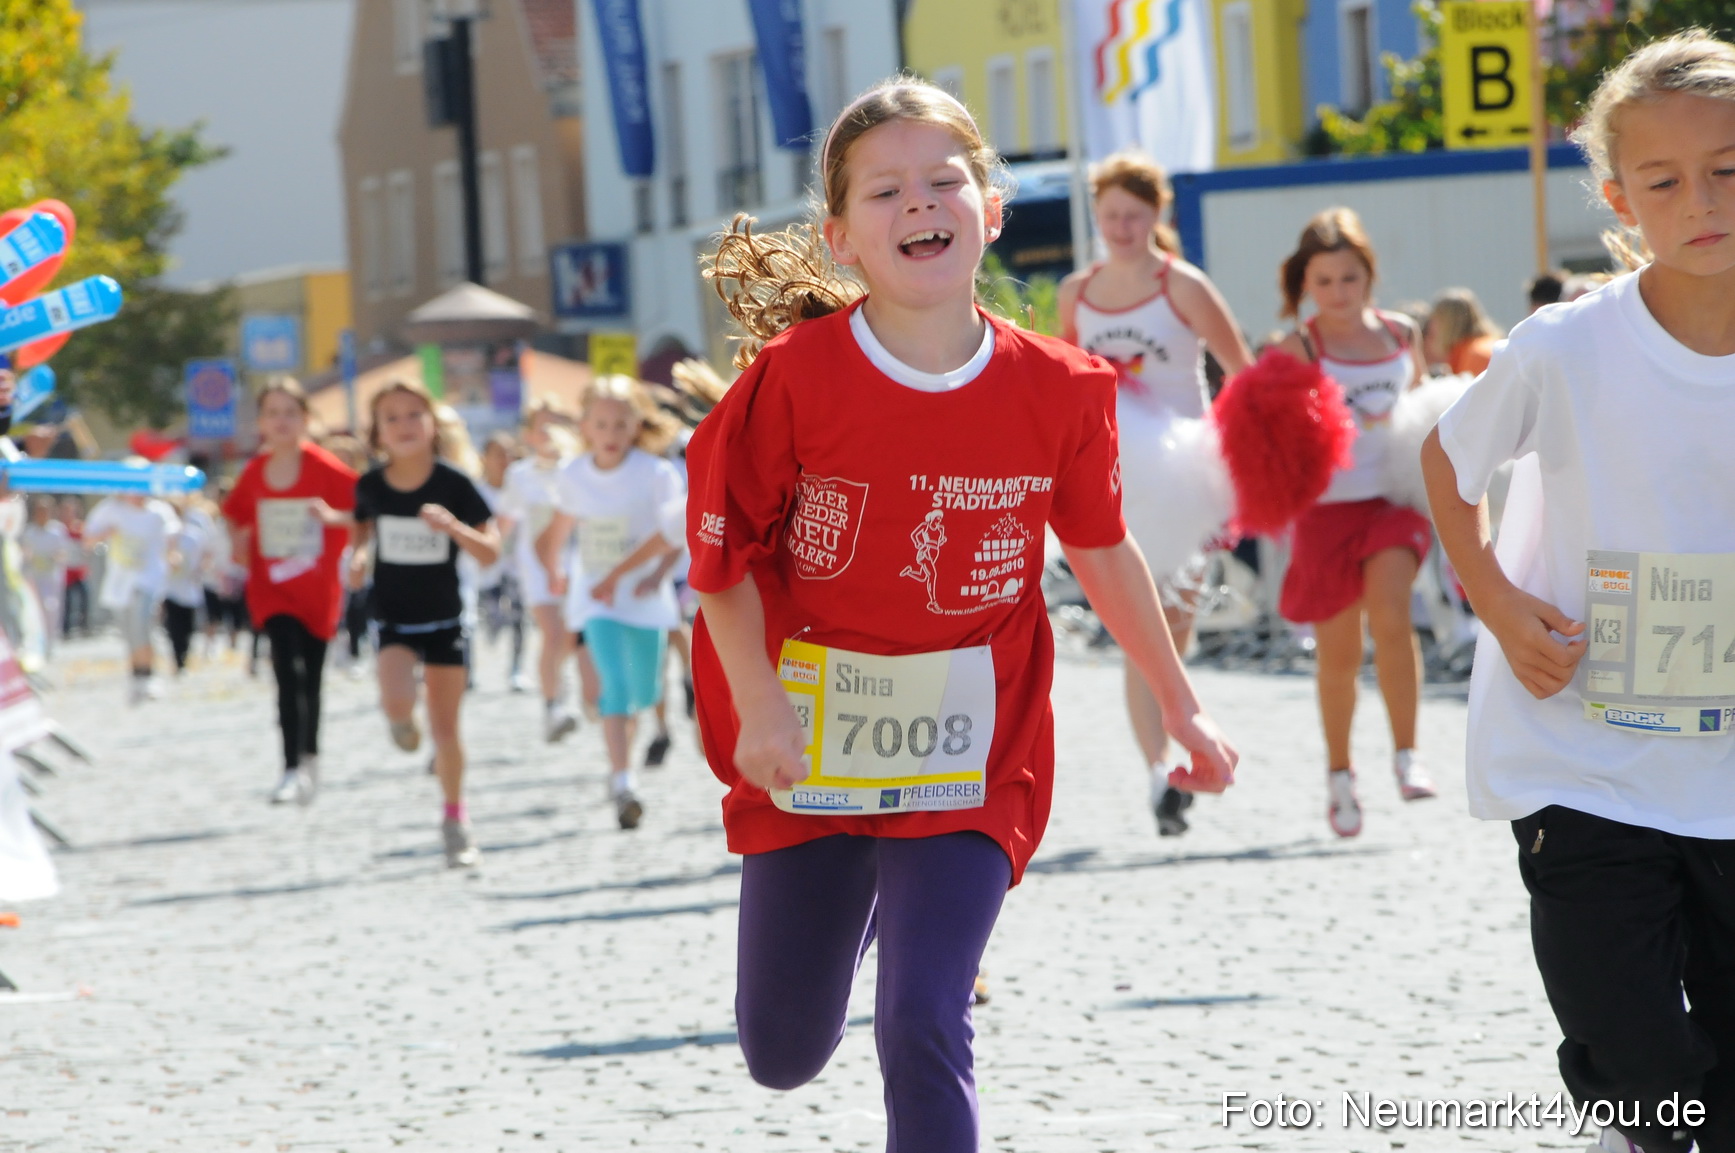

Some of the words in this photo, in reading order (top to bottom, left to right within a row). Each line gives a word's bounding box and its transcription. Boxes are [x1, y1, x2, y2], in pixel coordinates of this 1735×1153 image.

[1452, 5, 1522, 32] Block
[1472, 46, 1514, 111] B
[909, 474, 934, 491] 11.
[939, 475, 1053, 494] NEUMARKTER
[931, 491, 1027, 511] STADTLAUF
[793, 510, 841, 552] NEU
[787, 534, 837, 570] MARKT
[970, 556, 1025, 581] 19.09.2010
[1650, 566, 1713, 602] Nina
[1594, 618, 1622, 645] K3
[835, 662, 894, 698] Sina
[792, 705, 809, 728] 3
[1605, 708, 1665, 726] BOCK
[837, 713, 973, 758] 7008
[792, 791, 849, 805] BOCK
[903, 783, 981, 800] PFLEIDERER
